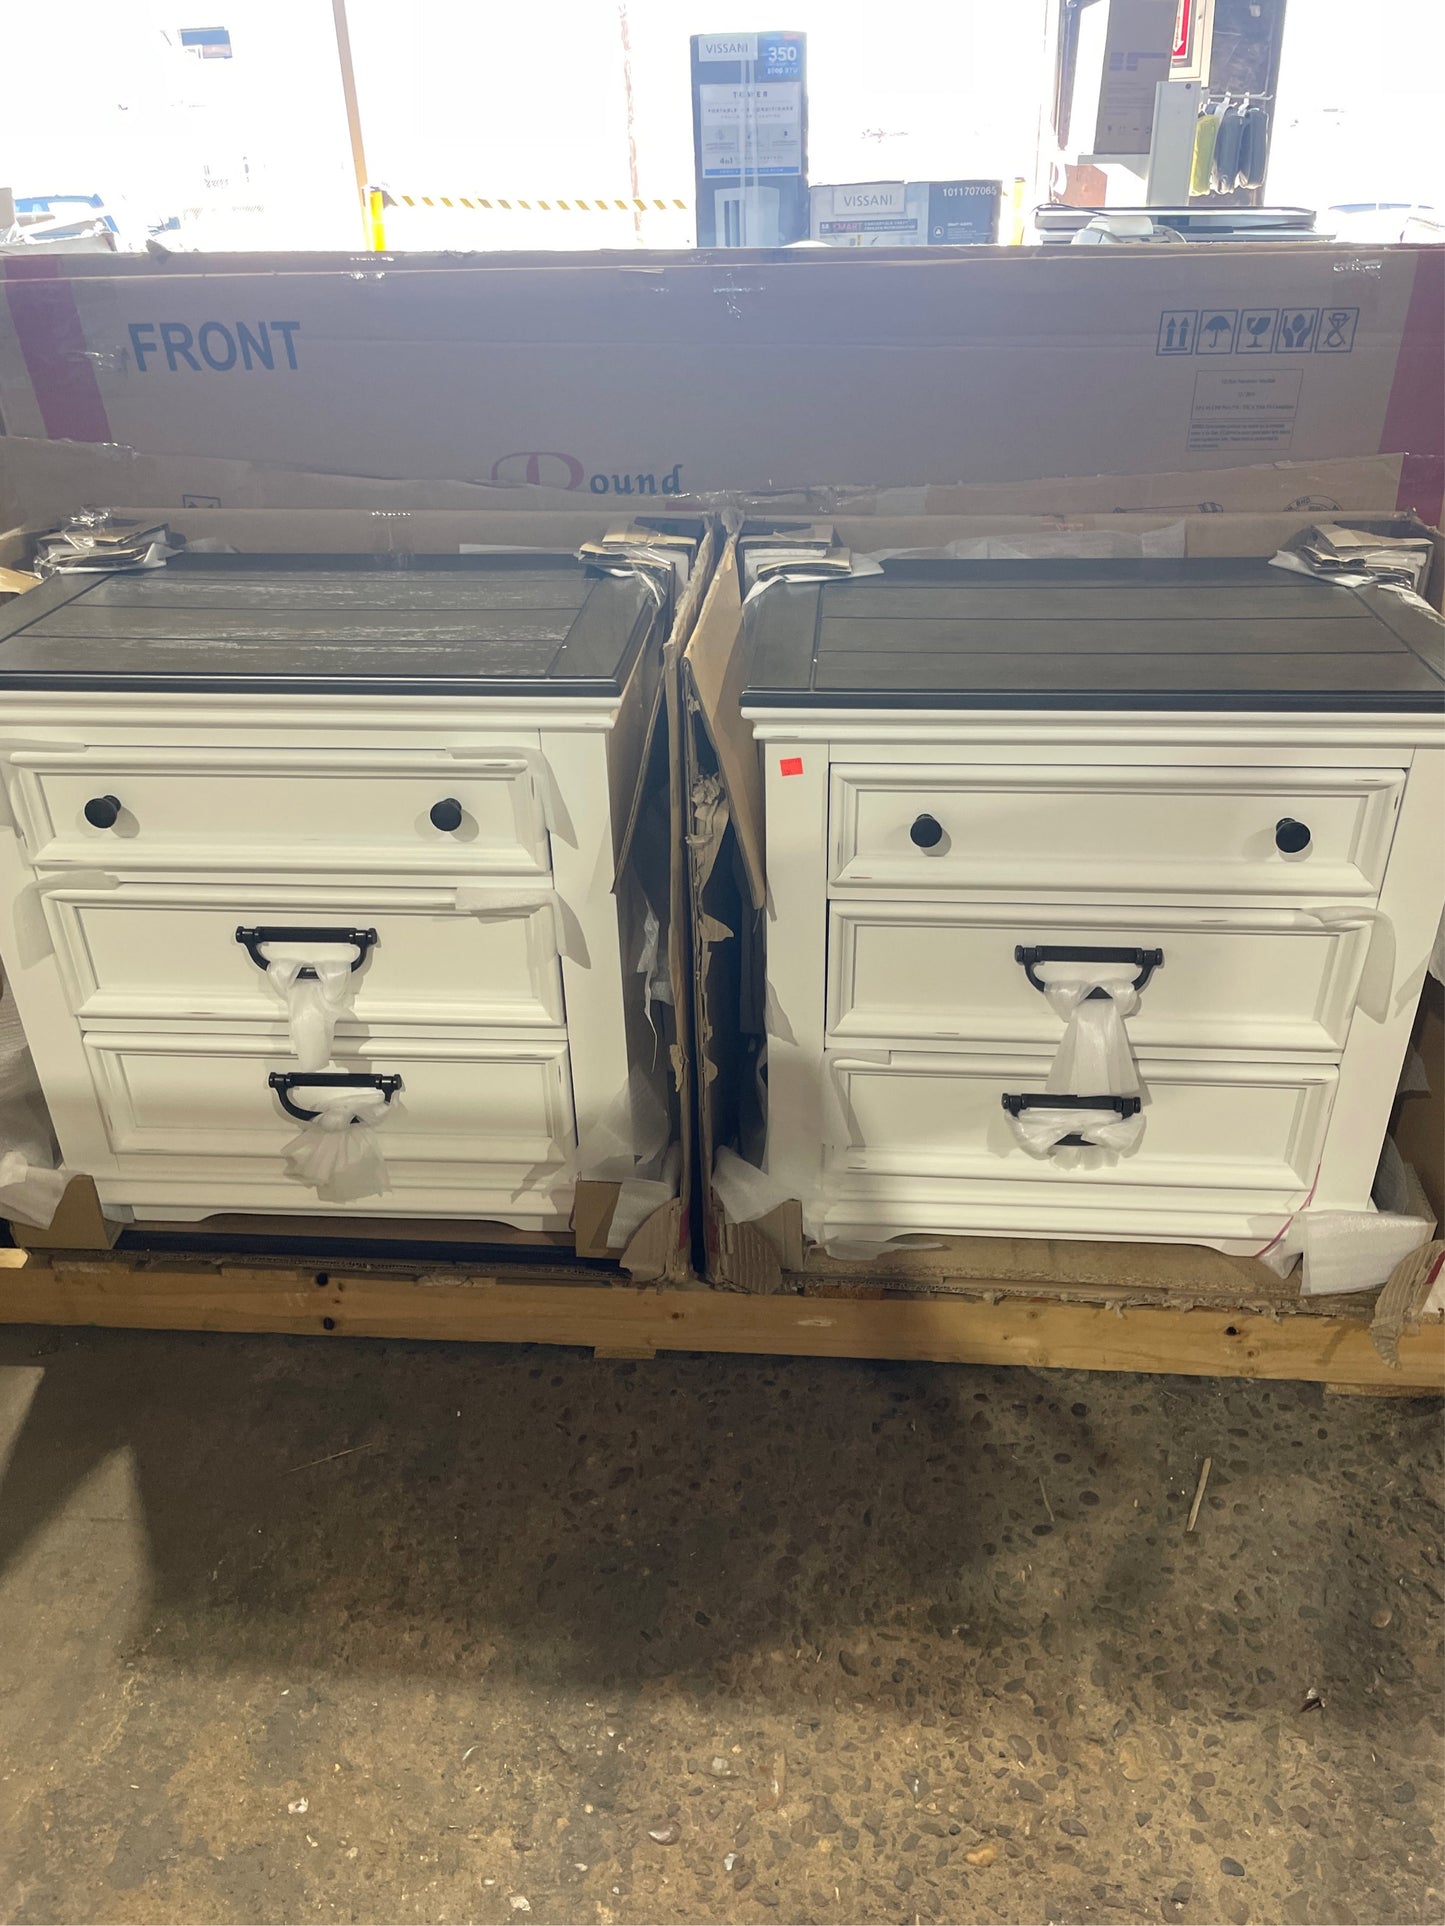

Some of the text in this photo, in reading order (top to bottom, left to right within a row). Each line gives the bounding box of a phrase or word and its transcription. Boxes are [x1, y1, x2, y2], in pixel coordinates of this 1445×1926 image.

[706, 43, 749, 54] VISSANI
[768, 46, 797, 62] 350
[943, 186, 997, 197] 1011707065
[844, 194, 893, 207] VISSANI
[128, 321, 301, 372] FRONT
